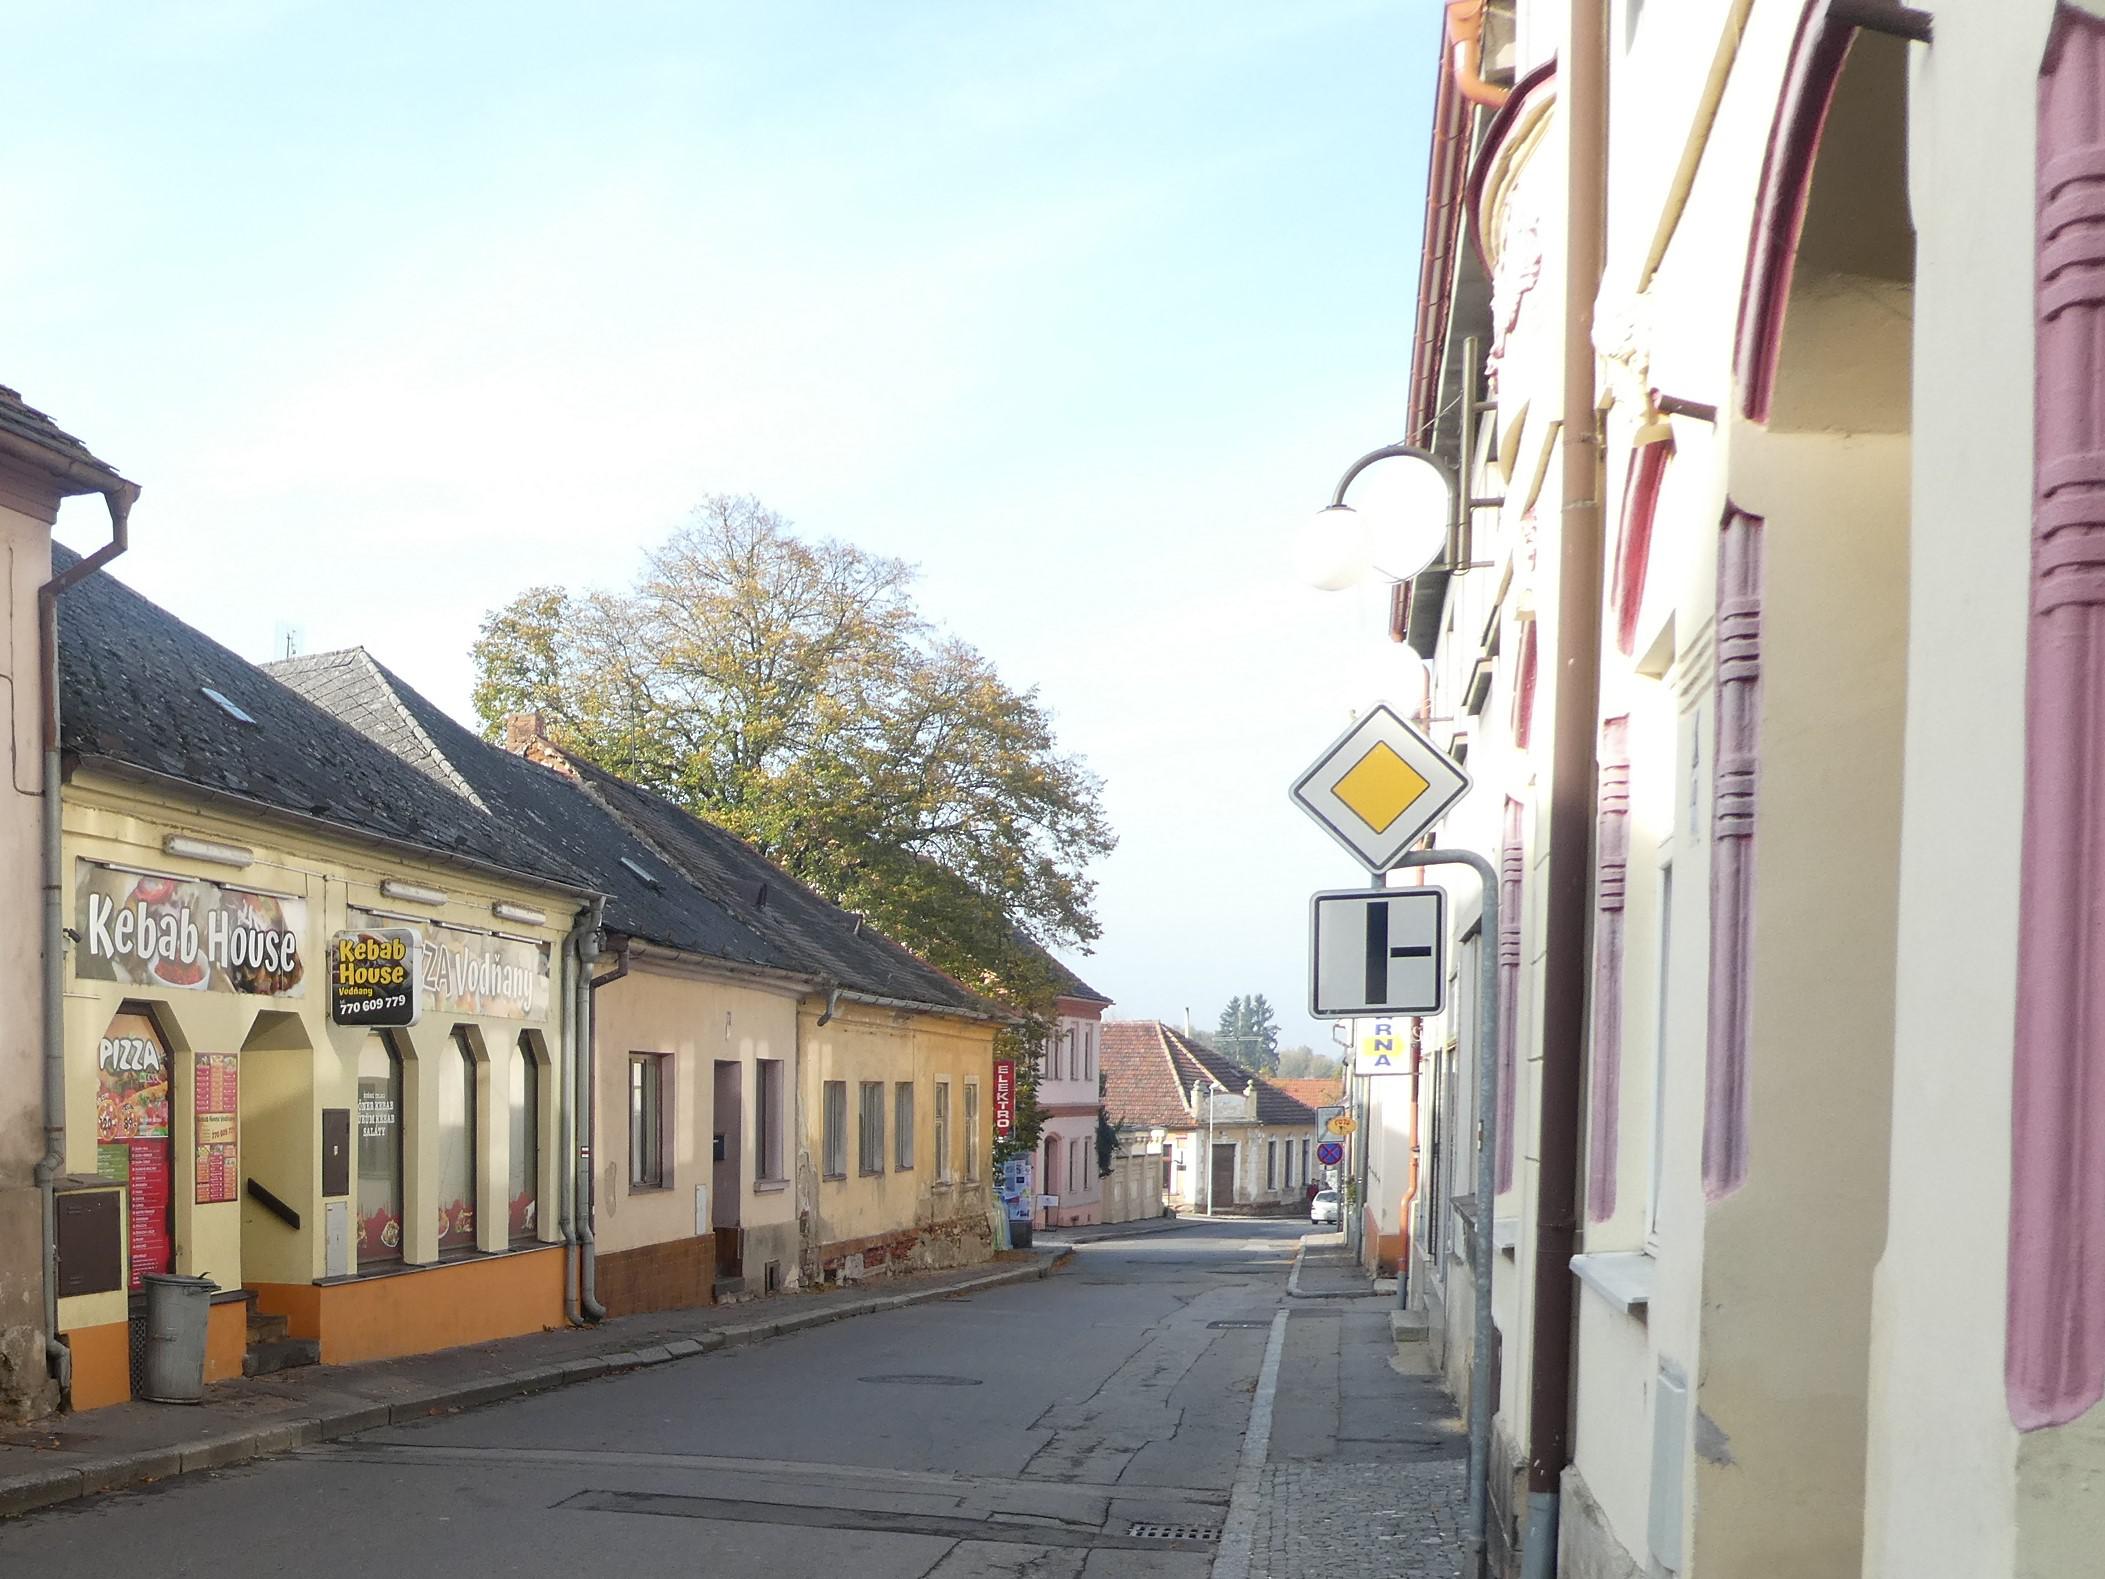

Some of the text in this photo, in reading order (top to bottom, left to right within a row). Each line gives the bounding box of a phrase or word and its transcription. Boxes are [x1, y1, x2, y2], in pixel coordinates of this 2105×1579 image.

[88, 892, 297, 973] Kebab House
[339, 937, 407, 962] Kebab
[339, 962, 405, 985] House
[455, 946, 533, 1012] Vodňany
[340, 994, 406, 1015] 770 609 779
[99, 1038, 160, 1071] PIZZA
[1374, 1016, 1393, 1067] RNA
[997, 1065, 1010, 1128] ELEKTRO
[362, 1124, 386, 1137] SALÁTY
